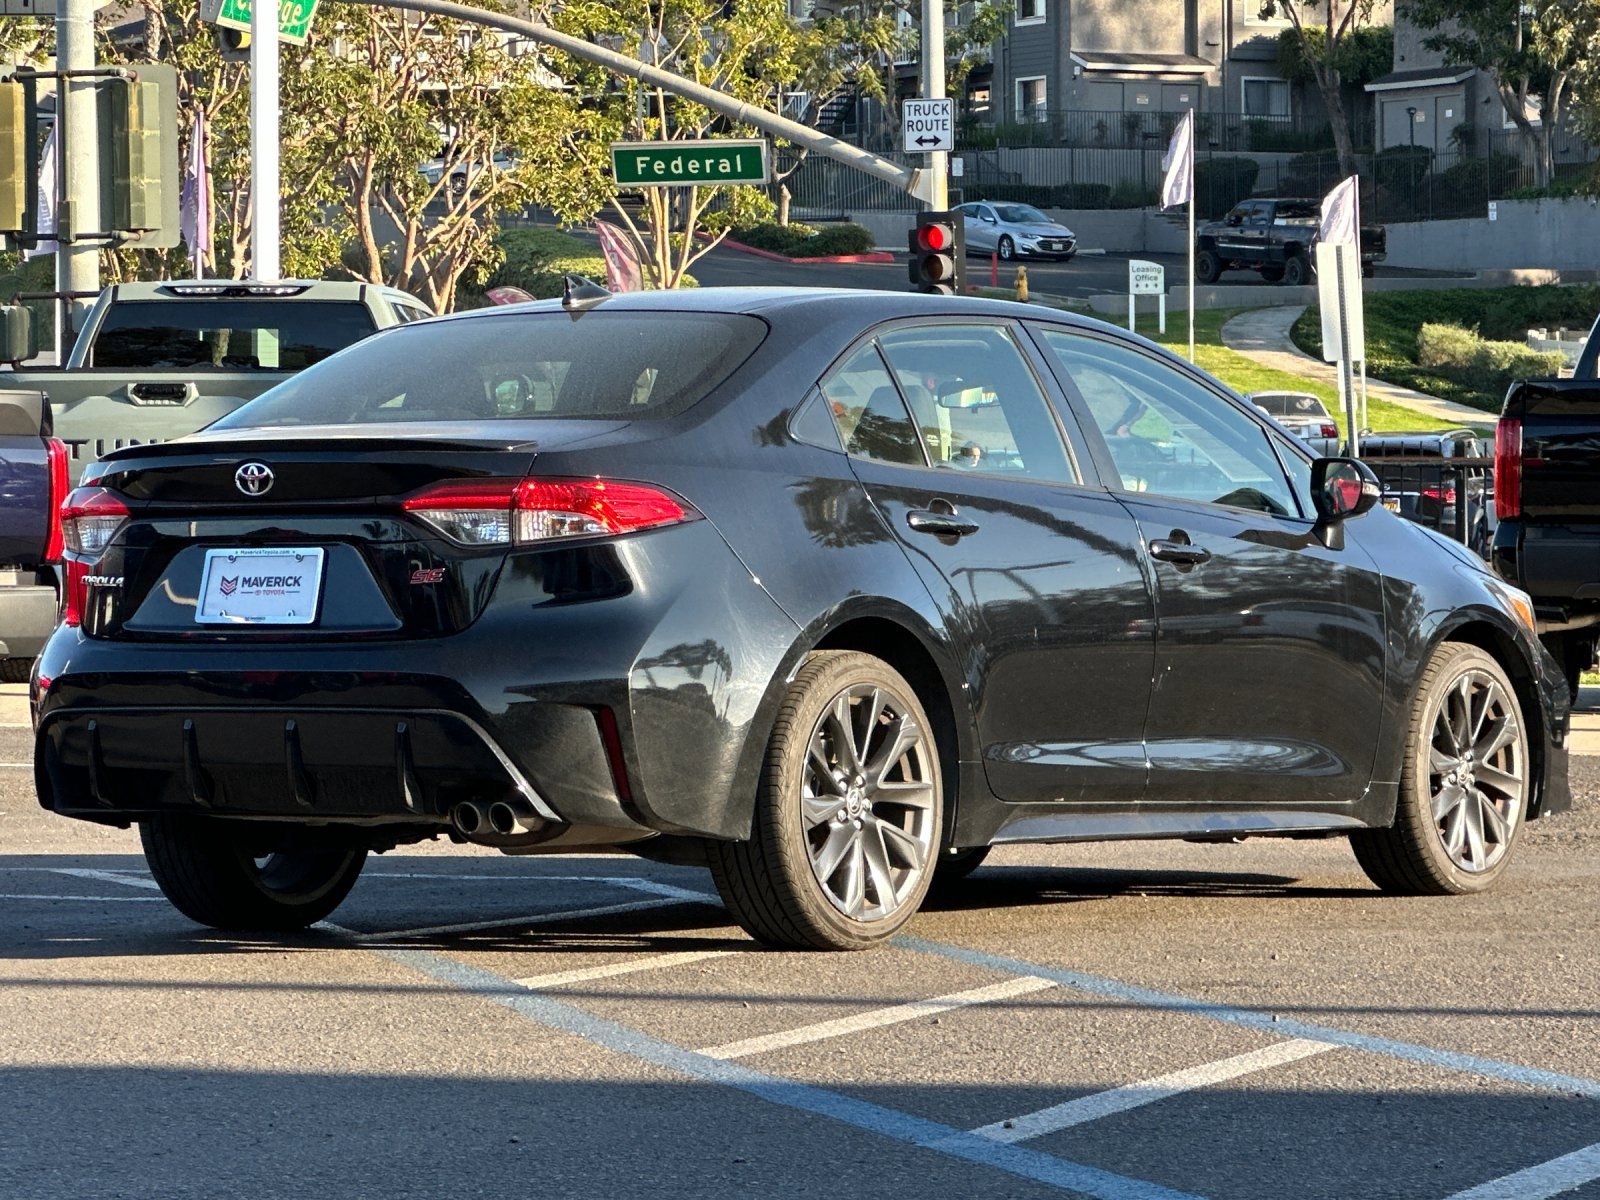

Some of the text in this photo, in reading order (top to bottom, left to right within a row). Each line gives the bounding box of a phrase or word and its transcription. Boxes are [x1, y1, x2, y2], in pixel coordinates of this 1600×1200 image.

[906, 103, 949, 116] TRUCK
[907, 119, 949, 132] ROUTE
[636, 154, 742, 175] Federal
[1131, 266, 1162, 274] Leasing
[241, 576, 302, 588] MAVERICK
[410, 568, 445, 584] SE
